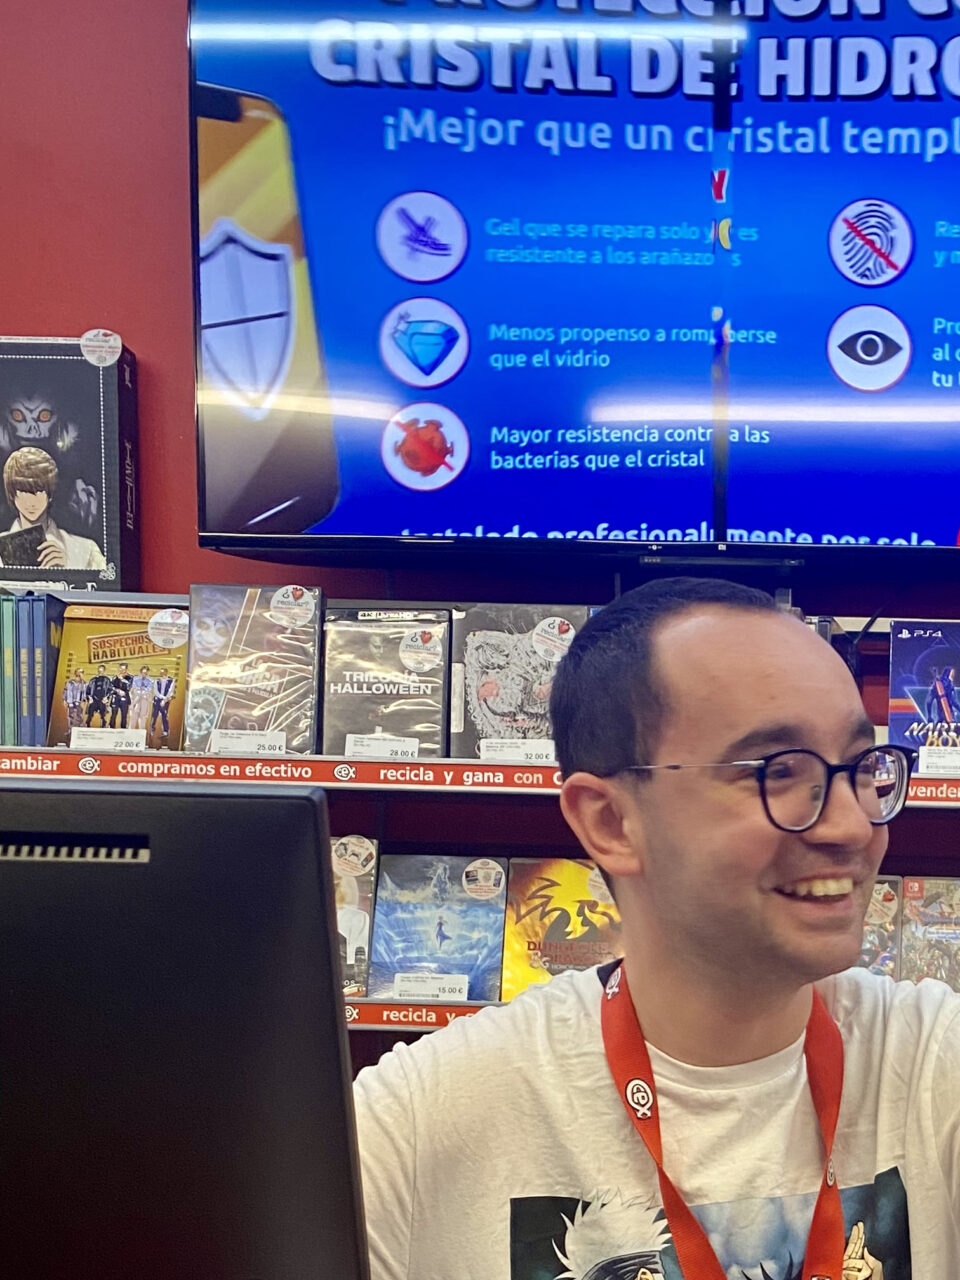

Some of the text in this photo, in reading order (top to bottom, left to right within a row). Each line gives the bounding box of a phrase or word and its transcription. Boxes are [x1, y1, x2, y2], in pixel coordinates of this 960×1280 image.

[309, 19, 613, 93] CRISTAL
[630, 33, 739, 97] DE
[383, 106, 524, 153] ¡Mejor
[536, 119, 612, 156] que
[624, 122, 673, 151] un
[489, 323, 555, 341] Menos
[560, 326, 650, 345] propenso
[655, 328, 667, 342] a
[489, 348, 611, 371] que el vidrio
[932, 343, 950, 362] al
[931, 370, 953, 388] tu
[490, 426, 552, 447] Mayor
[557, 425, 659, 444] resistencia
[744, 425, 771, 444] las
[490, 448, 706, 472] bacterias que el cristal
[92, 634, 151, 651] SOSPECHOS
[913, 629, 943, 638] PS4
[329, 682, 433, 696] HALLOWEEN
[0, 756, 313, 779] ambiar compramos en efectivo
[379, 766, 543, 786] recicla y gana con
[382, 1007, 437, 1023] recicla
